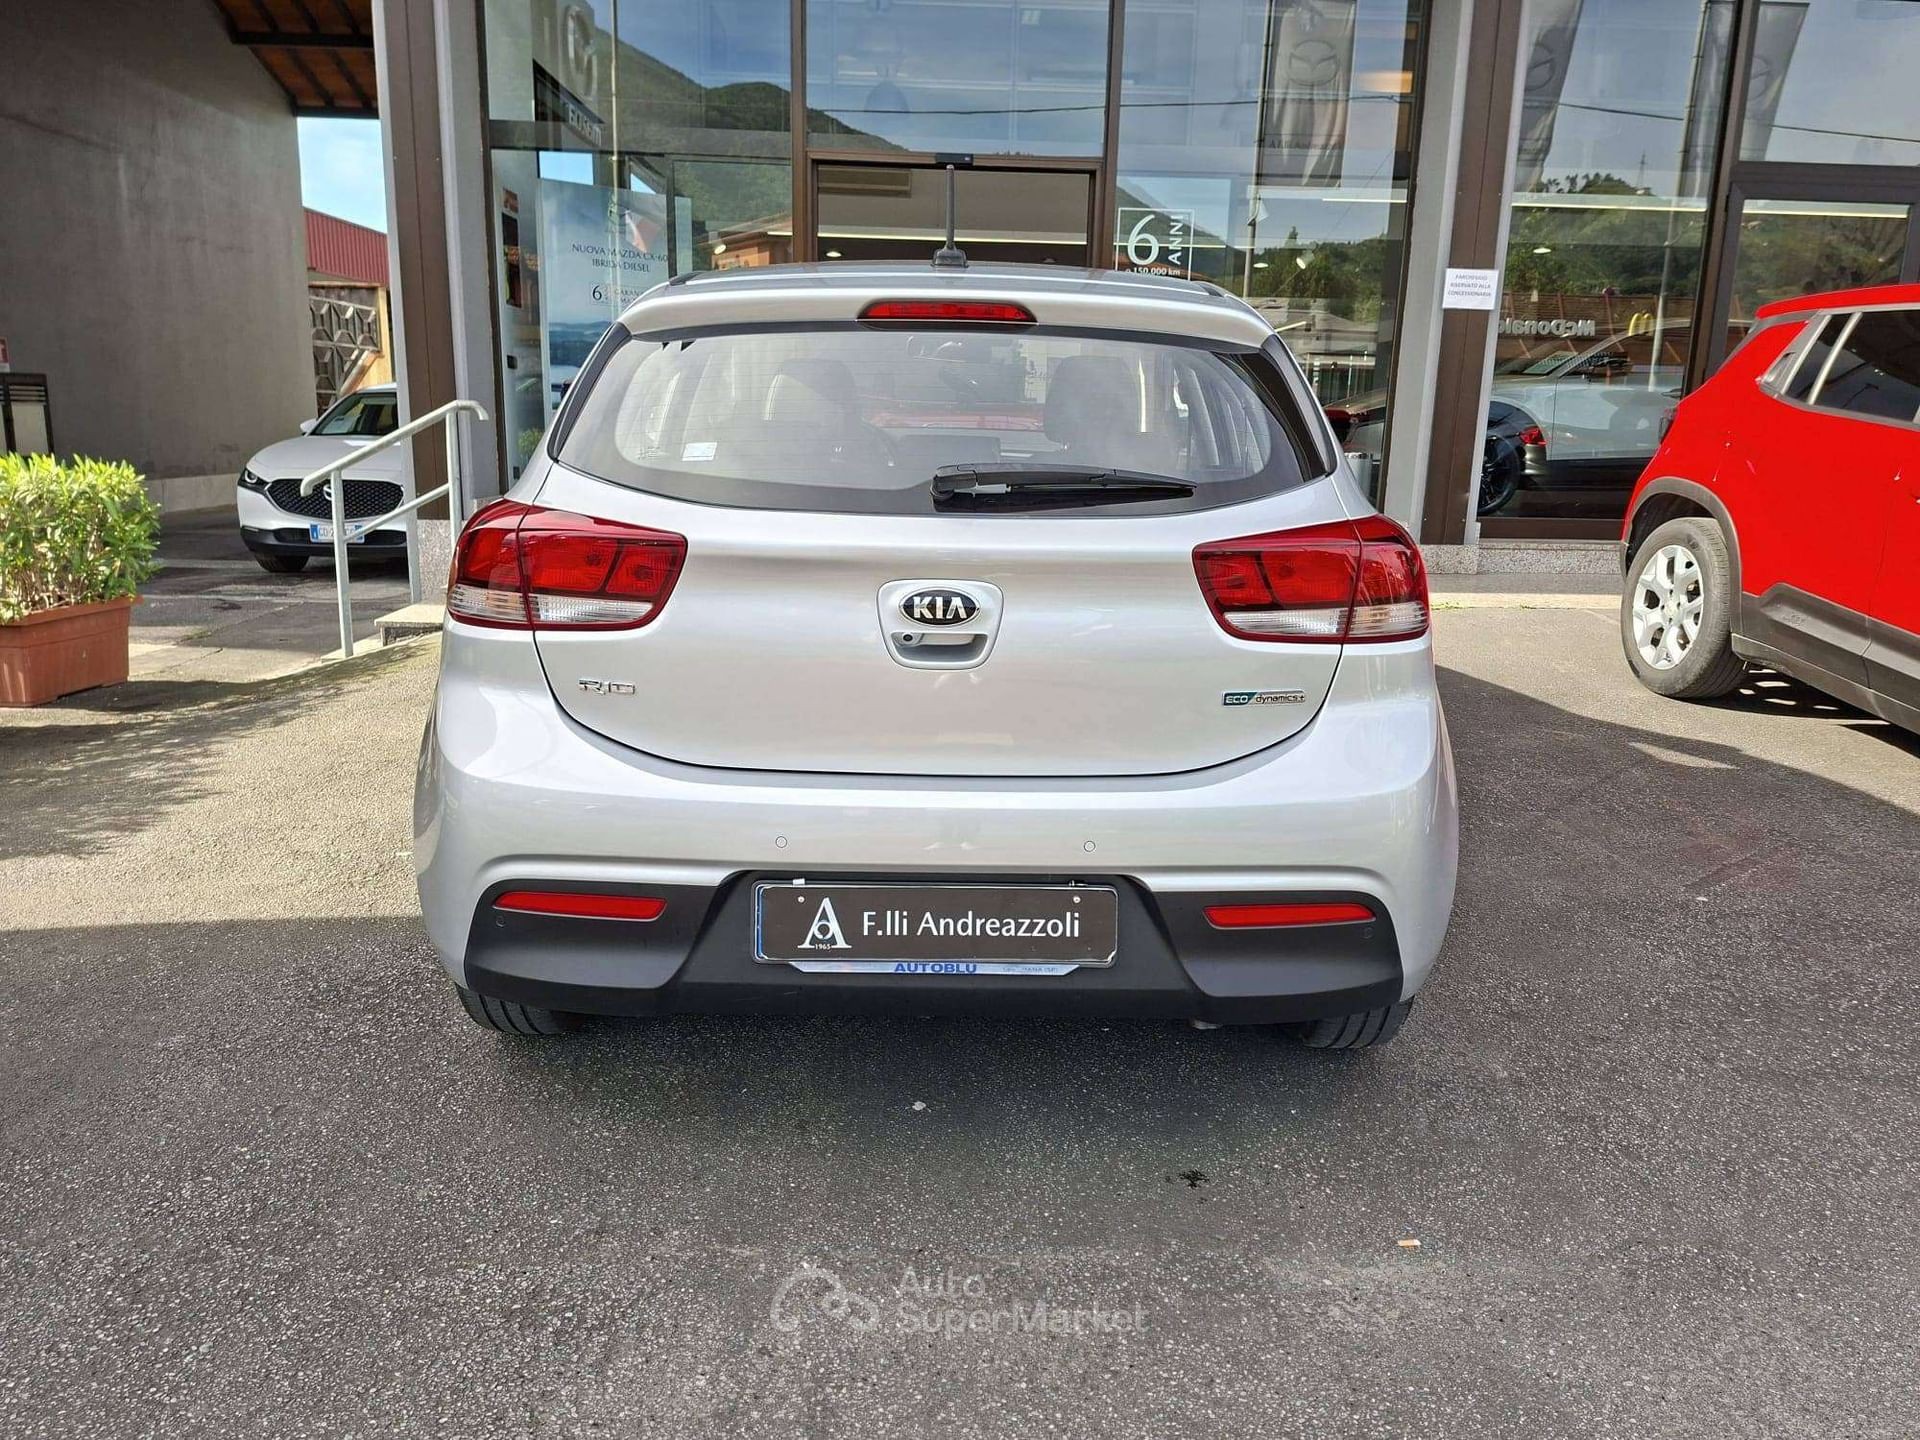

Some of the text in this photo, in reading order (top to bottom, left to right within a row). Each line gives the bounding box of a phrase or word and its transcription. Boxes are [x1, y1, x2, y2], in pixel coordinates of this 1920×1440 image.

[1127, 214, 1184, 266] 6 ANNI
[572, 243, 605, 255] NUOVA
[607, 247, 642, 260] MAZDA
[592, 258, 651, 273] IBRIDA DIESEL
[1168, 268, 1181, 276] km
[592, 284, 602, 301] 6
[912, 596, 968, 619] KIA
[578, 679, 636, 695] RIO
[1225, 694, 1249, 704] ECO
[863, 911, 1080, 937] F.lli Andreazzoli
[894, 963, 977, 975] AUTOBLU
